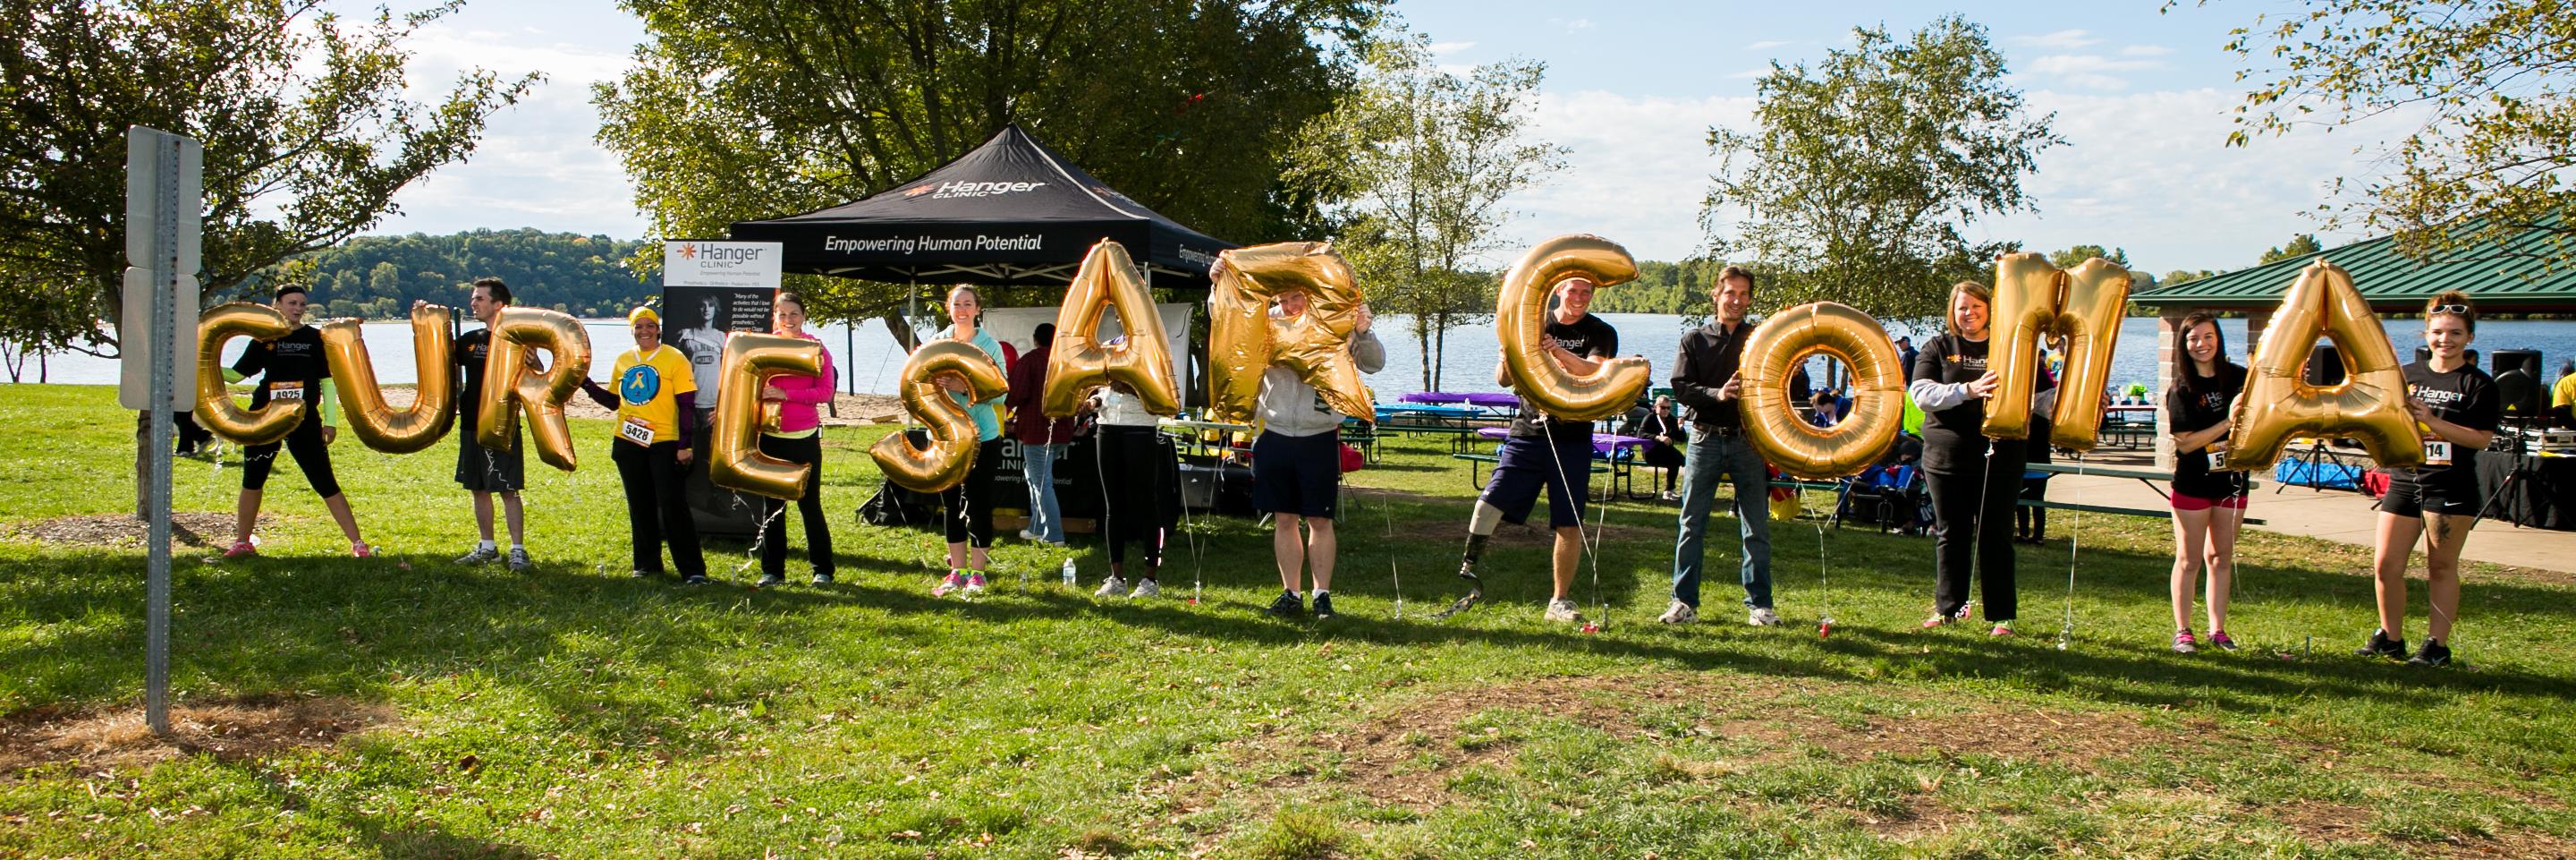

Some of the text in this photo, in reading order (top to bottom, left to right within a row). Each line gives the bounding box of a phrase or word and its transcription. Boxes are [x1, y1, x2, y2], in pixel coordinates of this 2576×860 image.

[936, 181, 1046, 194] Hanger
[826, 234, 1042, 254] Empowering Human Potential
[700, 243, 764, 265] Hanger
[1179, 243, 1206, 267] Empowering
[700, 260, 734, 268] CLINIC
[276, 342, 311, 350] Hanger
[1963, 355, 1987, 364] Han
[2417, 386, 2466, 402] Hanger
[626, 424, 648, 441] 5428
[2425, 443, 2443, 457] 14
